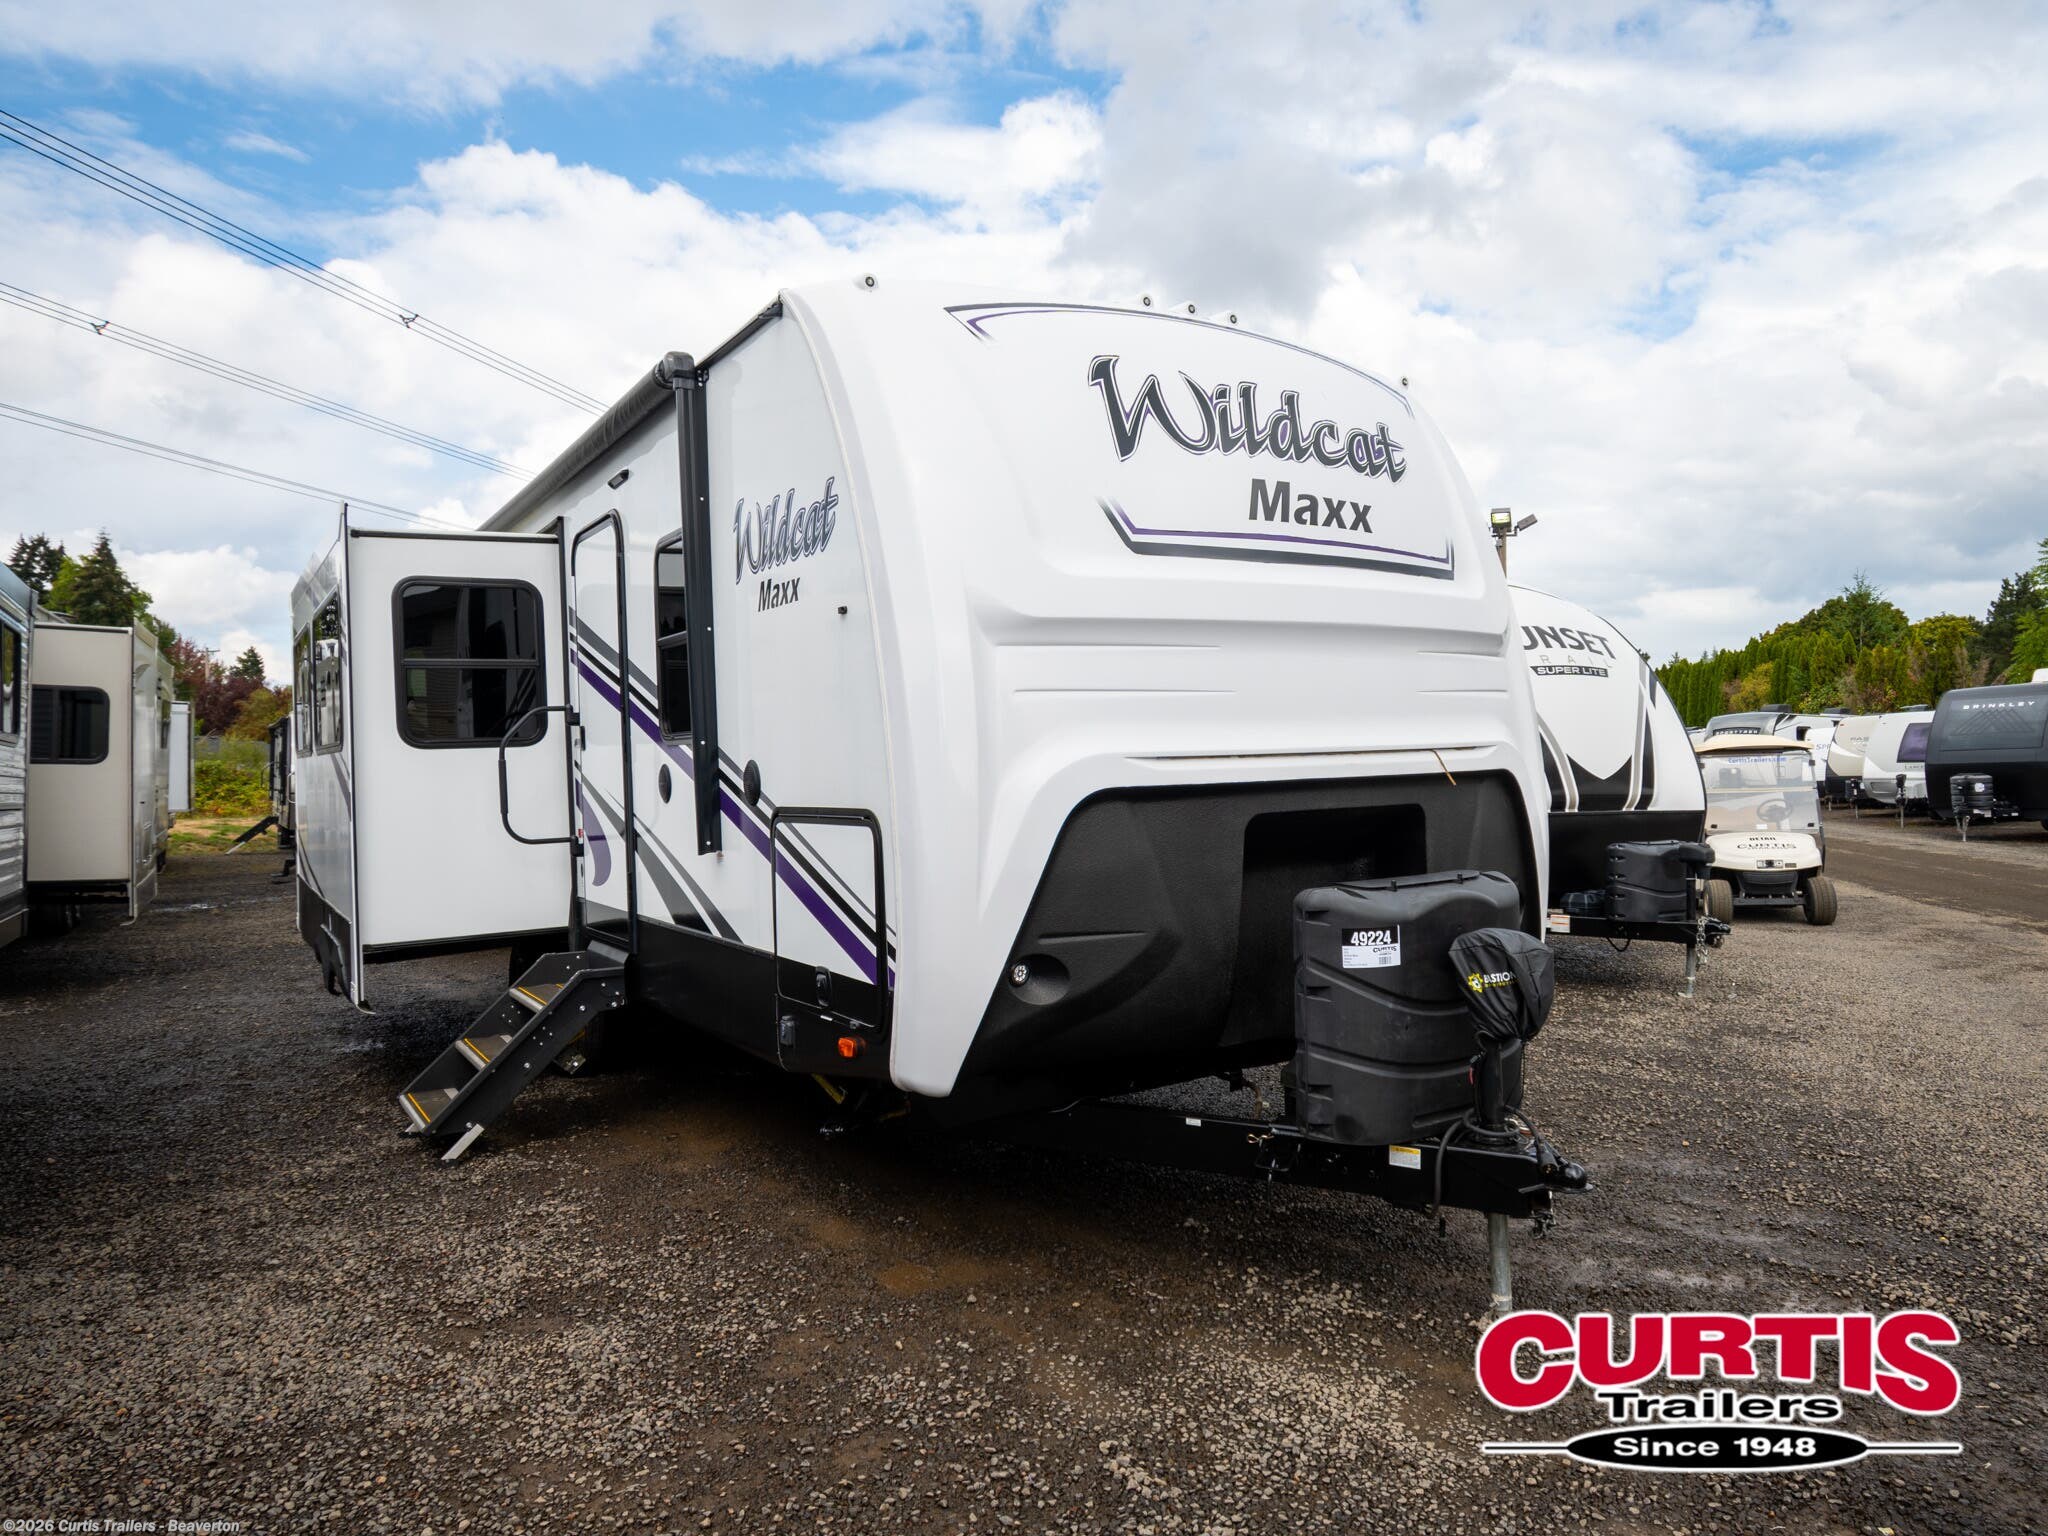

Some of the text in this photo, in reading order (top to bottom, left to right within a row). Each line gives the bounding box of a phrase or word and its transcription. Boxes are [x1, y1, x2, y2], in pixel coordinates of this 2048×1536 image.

[1088, 355, 1407, 483] Wildcat
[1248, 478, 1373, 533] Maxx
[733, 476, 839, 585] Wildcat
[758, 577, 801, 612] Maxx
[1520, 625, 1617, 660] UNSET
[1537, 666, 1607, 676] SUPER LITE
[1962, 701, 2036, 710] BRINKLEY
[1350, 930, 1392, 946] 49224
[1373, 945, 1397, 953] CURTIS
